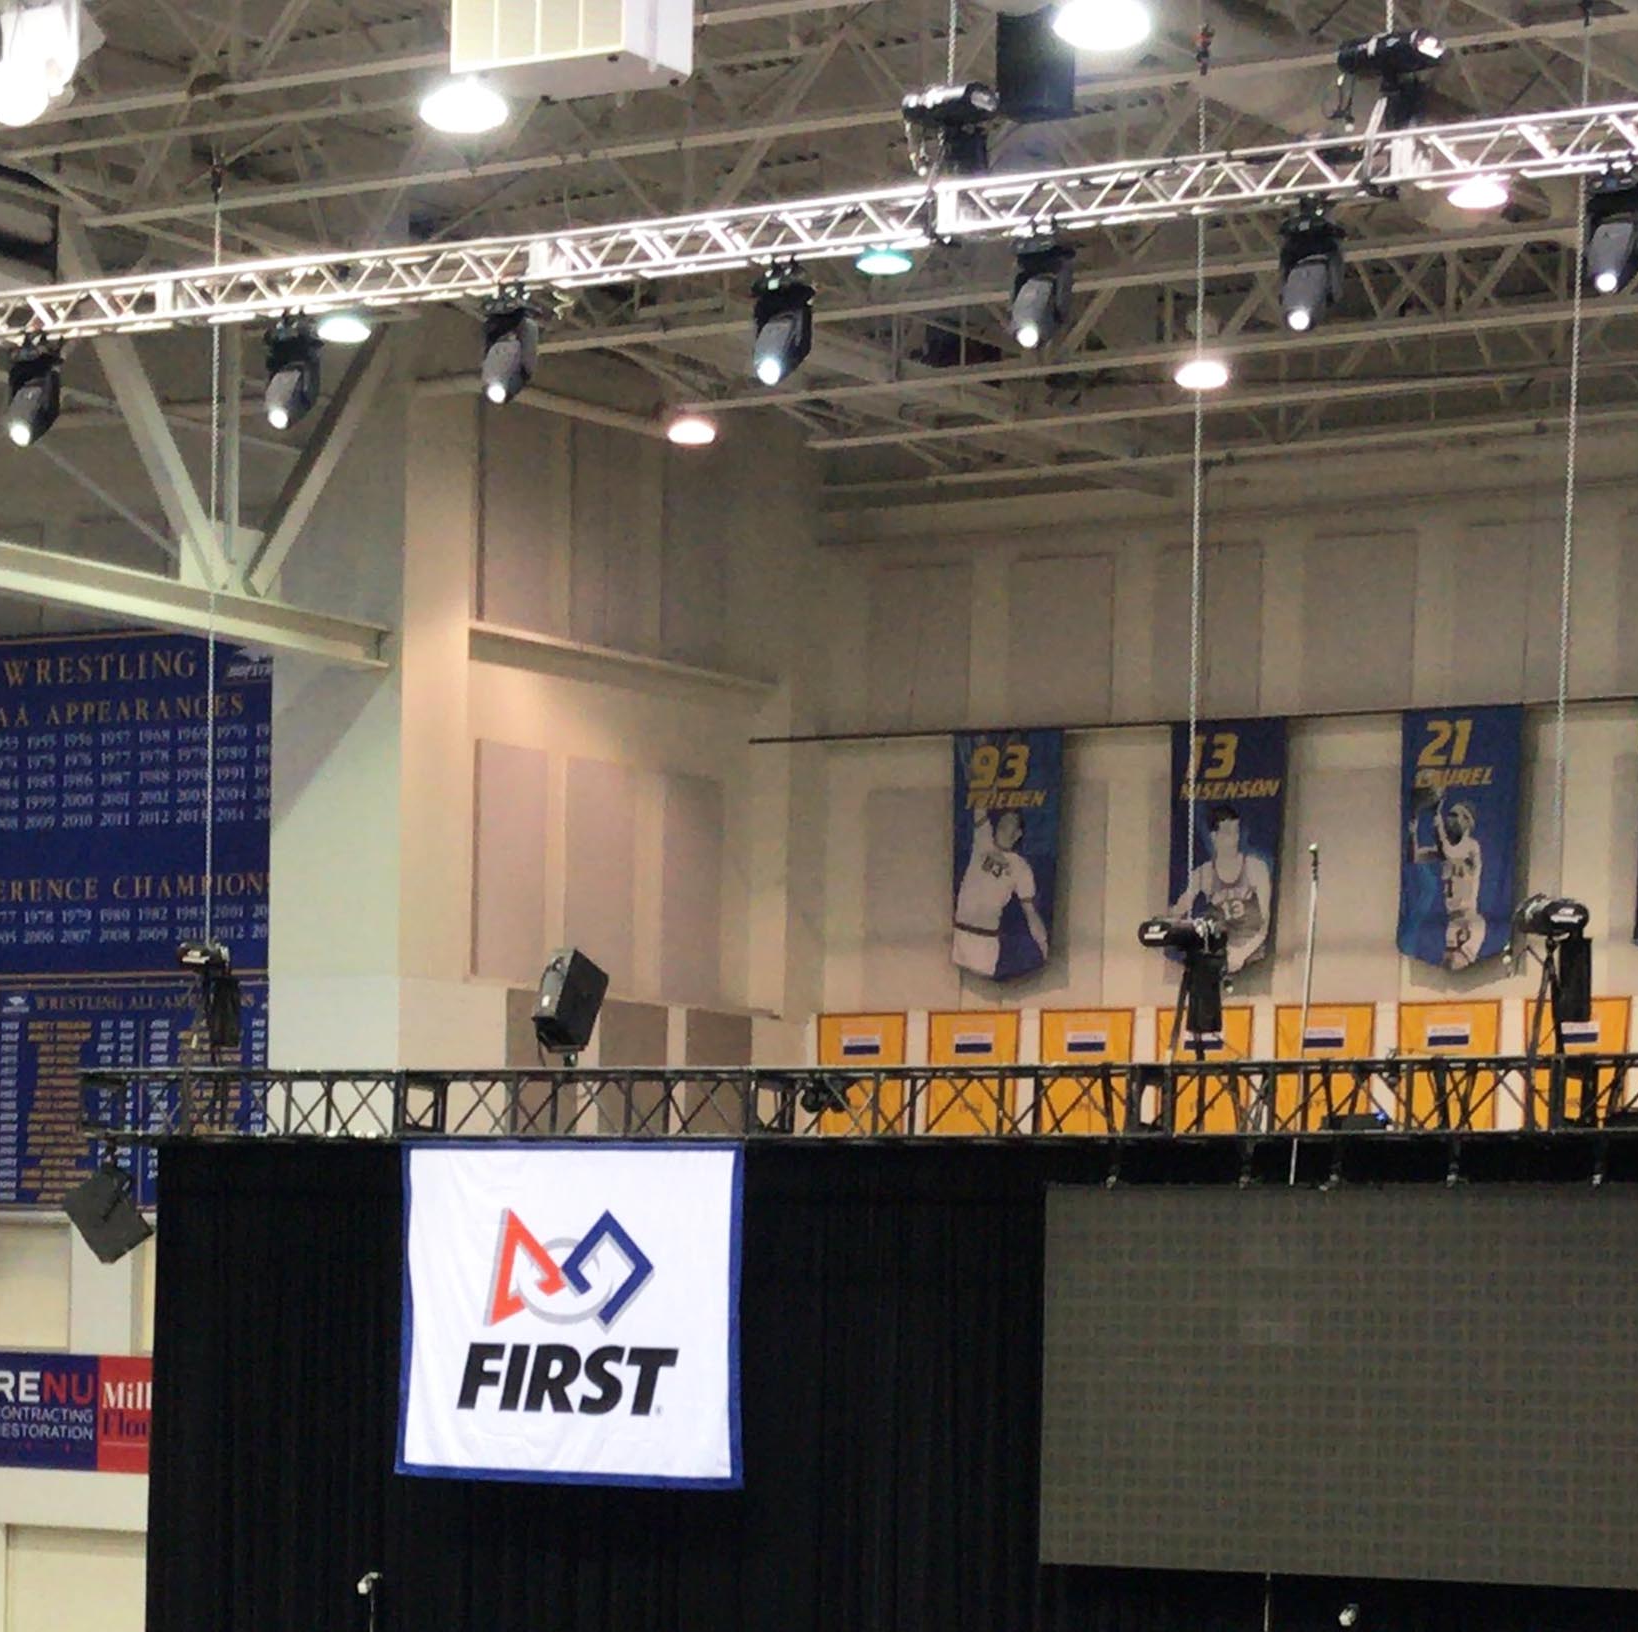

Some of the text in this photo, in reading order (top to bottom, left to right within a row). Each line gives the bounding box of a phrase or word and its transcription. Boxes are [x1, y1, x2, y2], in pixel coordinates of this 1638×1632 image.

[4, 650, 196, 688] WRESTLING
[46, 692, 244, 727] APPEARANCES
[1185, 732, 1239, 779] 13
[1417, 719, 1473, 766] 21
[969, 744, 1031, 789] 93
[113, 872, 270, 899] CHAMPION
[456, 1342, 680, 1416] FIRST
